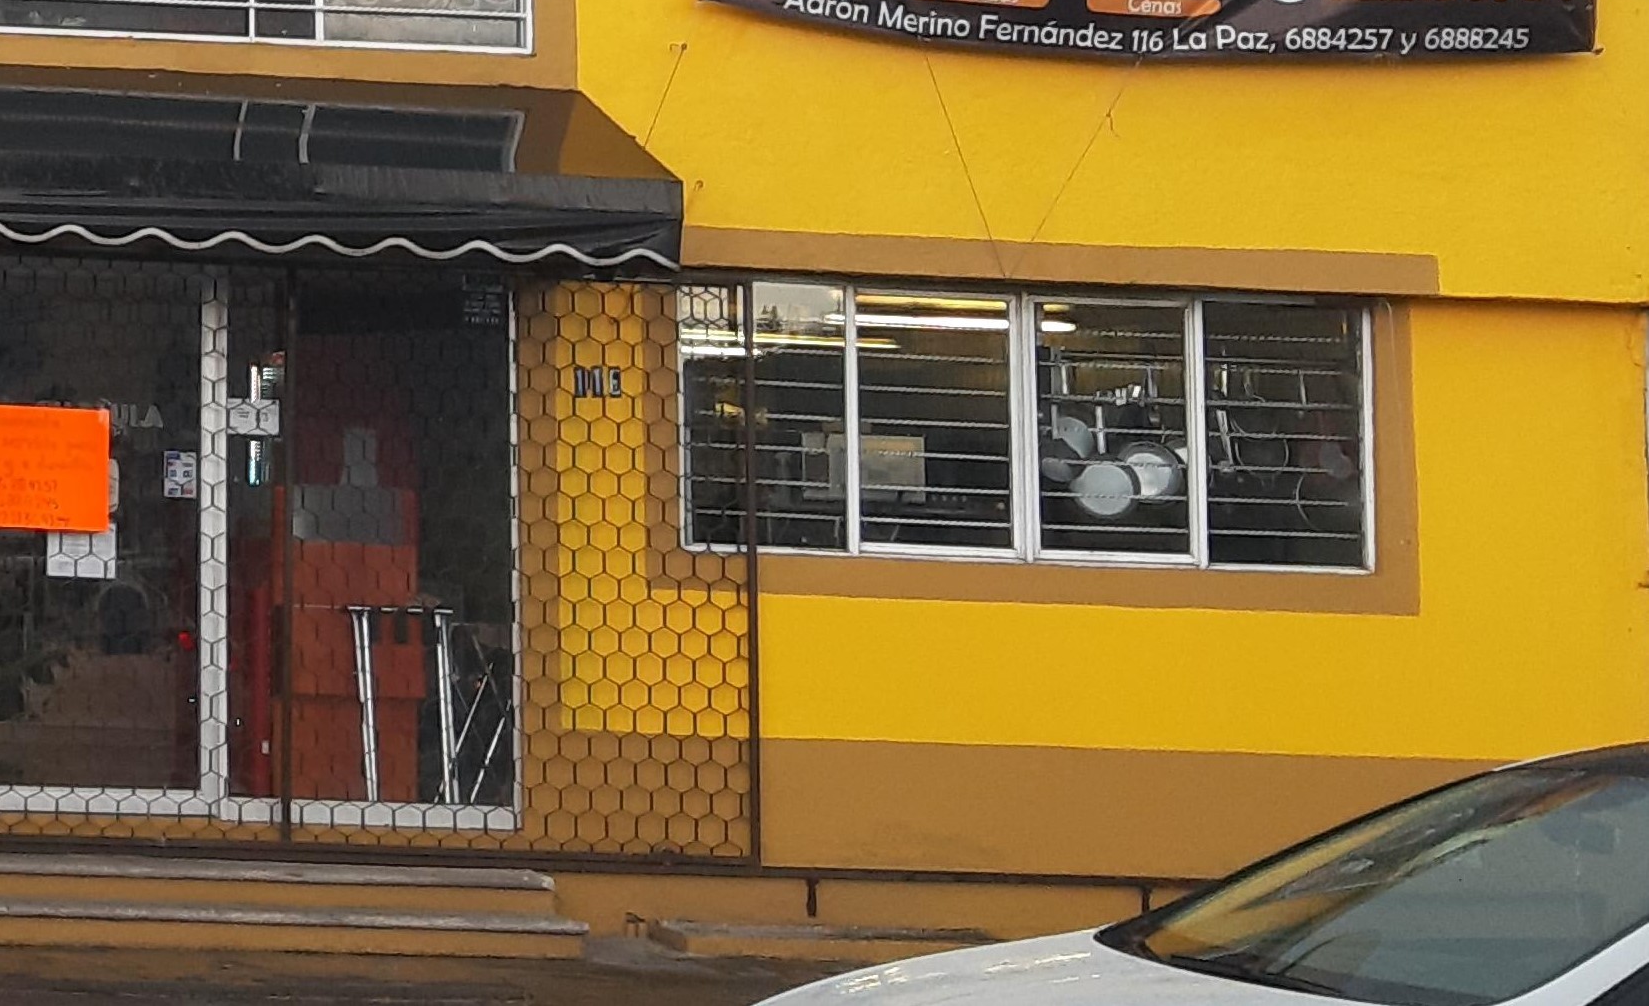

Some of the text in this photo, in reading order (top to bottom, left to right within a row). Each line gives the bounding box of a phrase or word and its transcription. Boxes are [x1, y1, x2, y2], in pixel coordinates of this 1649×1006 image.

[878, 1, 970, 38] Merino
[980, 15, 1122, 51] Fernández
[1132, 28, 1163, 53] 116
[1173, 27, 1207, 52] La
[1216, 25, 1276, 52] Paz,
[1285, 27, 1393, 50] 6884257
[1400, 31, 1417, 50] y
[1424, 27, 1530, 50] 6888245
